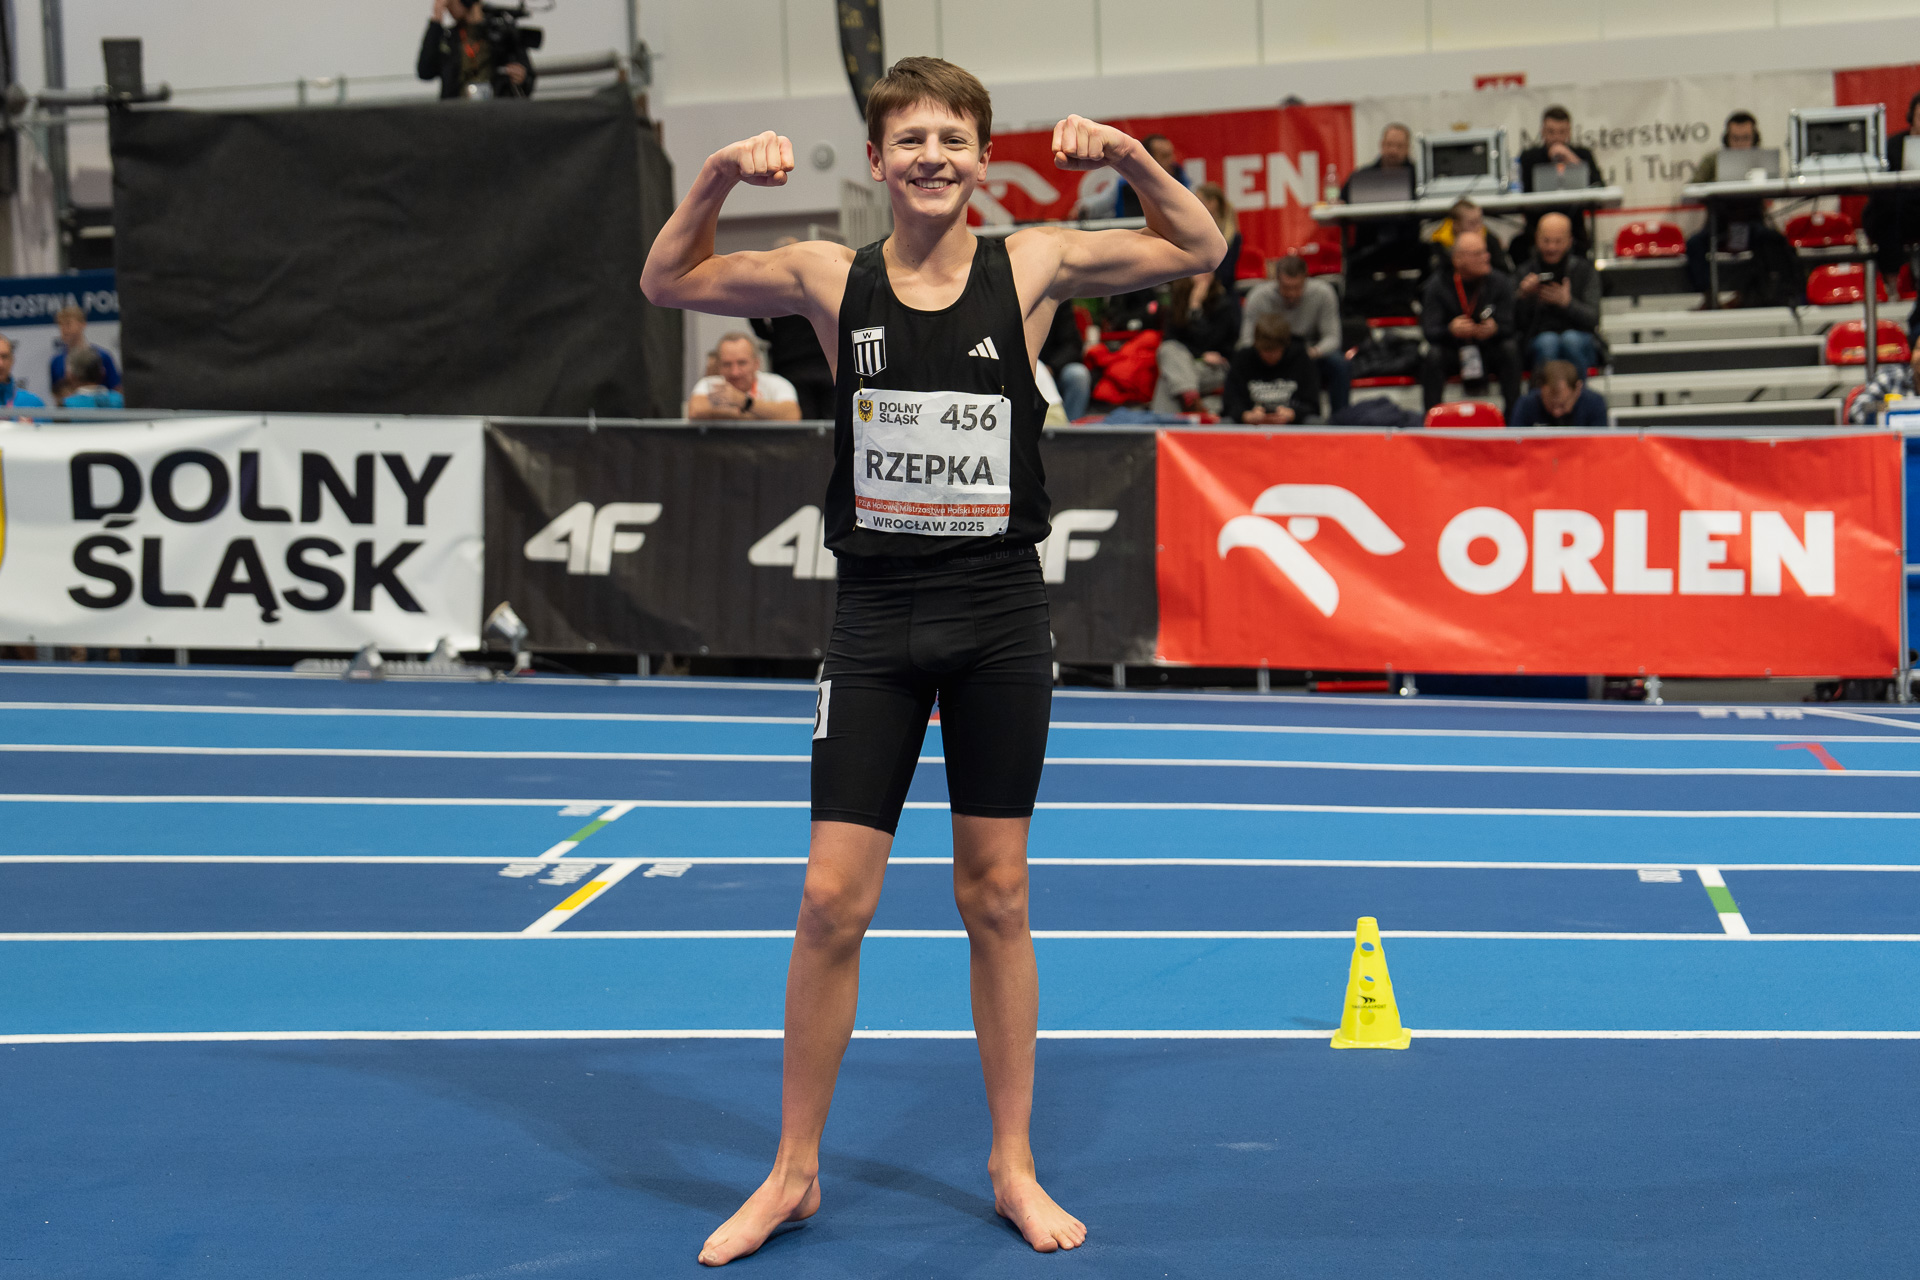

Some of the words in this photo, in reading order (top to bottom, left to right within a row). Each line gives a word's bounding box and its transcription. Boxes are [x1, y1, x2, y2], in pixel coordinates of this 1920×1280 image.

[879, 402, 923, 414] DOLNY
[879, 411, 919, 426] ŚLĄSK
[940, 403, 997, 431] 456
[866, 449, 995, 486] RZEPKA
[69, 448, 454, 526] DOLNY
[523, 501, 663, 575] 4F
[748, 504, 837, 579] 4
[1039, 508, 1119, 584] F
[872, 516, 947, 532] WROCŁAW
[950, 521, 985, 532] 2025
[67, 516, 428, 623] ŚLĄSK
[1437, 506, 1836, 597] ORLEN
